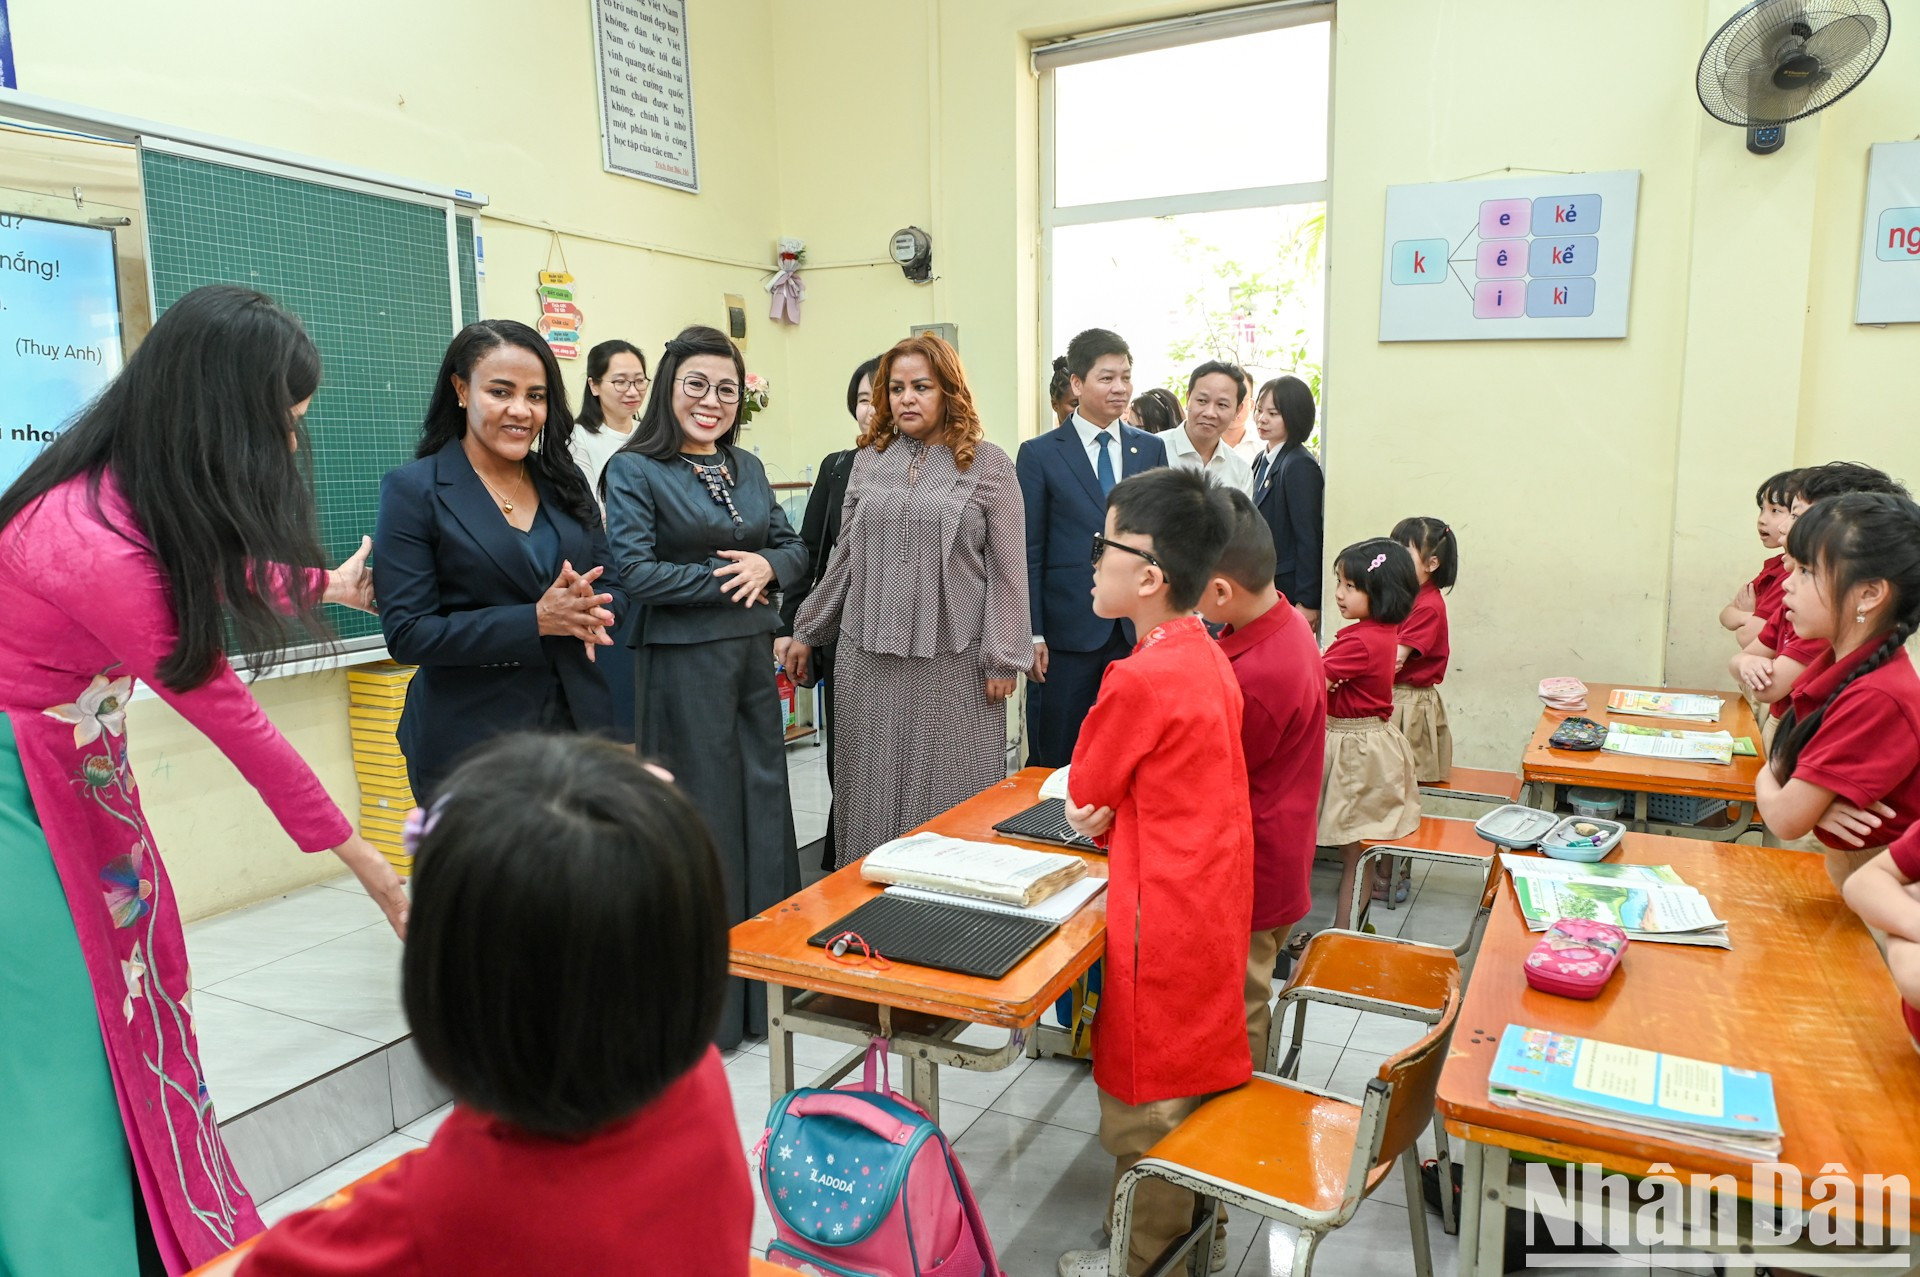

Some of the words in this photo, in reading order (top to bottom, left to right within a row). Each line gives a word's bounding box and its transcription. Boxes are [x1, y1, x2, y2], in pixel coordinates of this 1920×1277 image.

[663, 4, 679, 18] Nam
[668, 22, 679, 36] hay
[606, 30, 623, 45] Nam
[628, 40, 636, 50] có
[672, 56, 682, 67] đài
[668, 38, 681, 52] Việt
[625, 57, 646, 72] quang
[657, 67, 672, 79] sánh
[673, 73, 683, 83] vai
[609, 67, 620, 78] với
[626, 73, 637, 84] các
[643, 80, 663, 94] cường
[668, 87, 683, 99] quốc
[640, 110, 659, 123] chính
[664, 116, 670, 126] là
[673, 104, 684, 117] hay
[651, 129, 661, 140] lớn
[614, 135, 626, 147] học
[628, 139, 638, 152] tập
[640, 142, 651, 153] của
[652, 146, 662, 156] các
[1500, 214, 1510, 225] e
[1556, 204, 1577, 223] kẻ
[1414, 251, 1425, 273] k
[1497, 250, 1507, 266] ê
[1553, 245, 1574, 264] kể
[0, 251, 59, 281] nắng!
[1497, 291, 1502, 306] i
[1554, 286, 1568, 304] kì
[64, 345, 102, 366] Anh)
[12, 424, 61, 442] nha
[809, 1168, 853, 1194] LADODA
